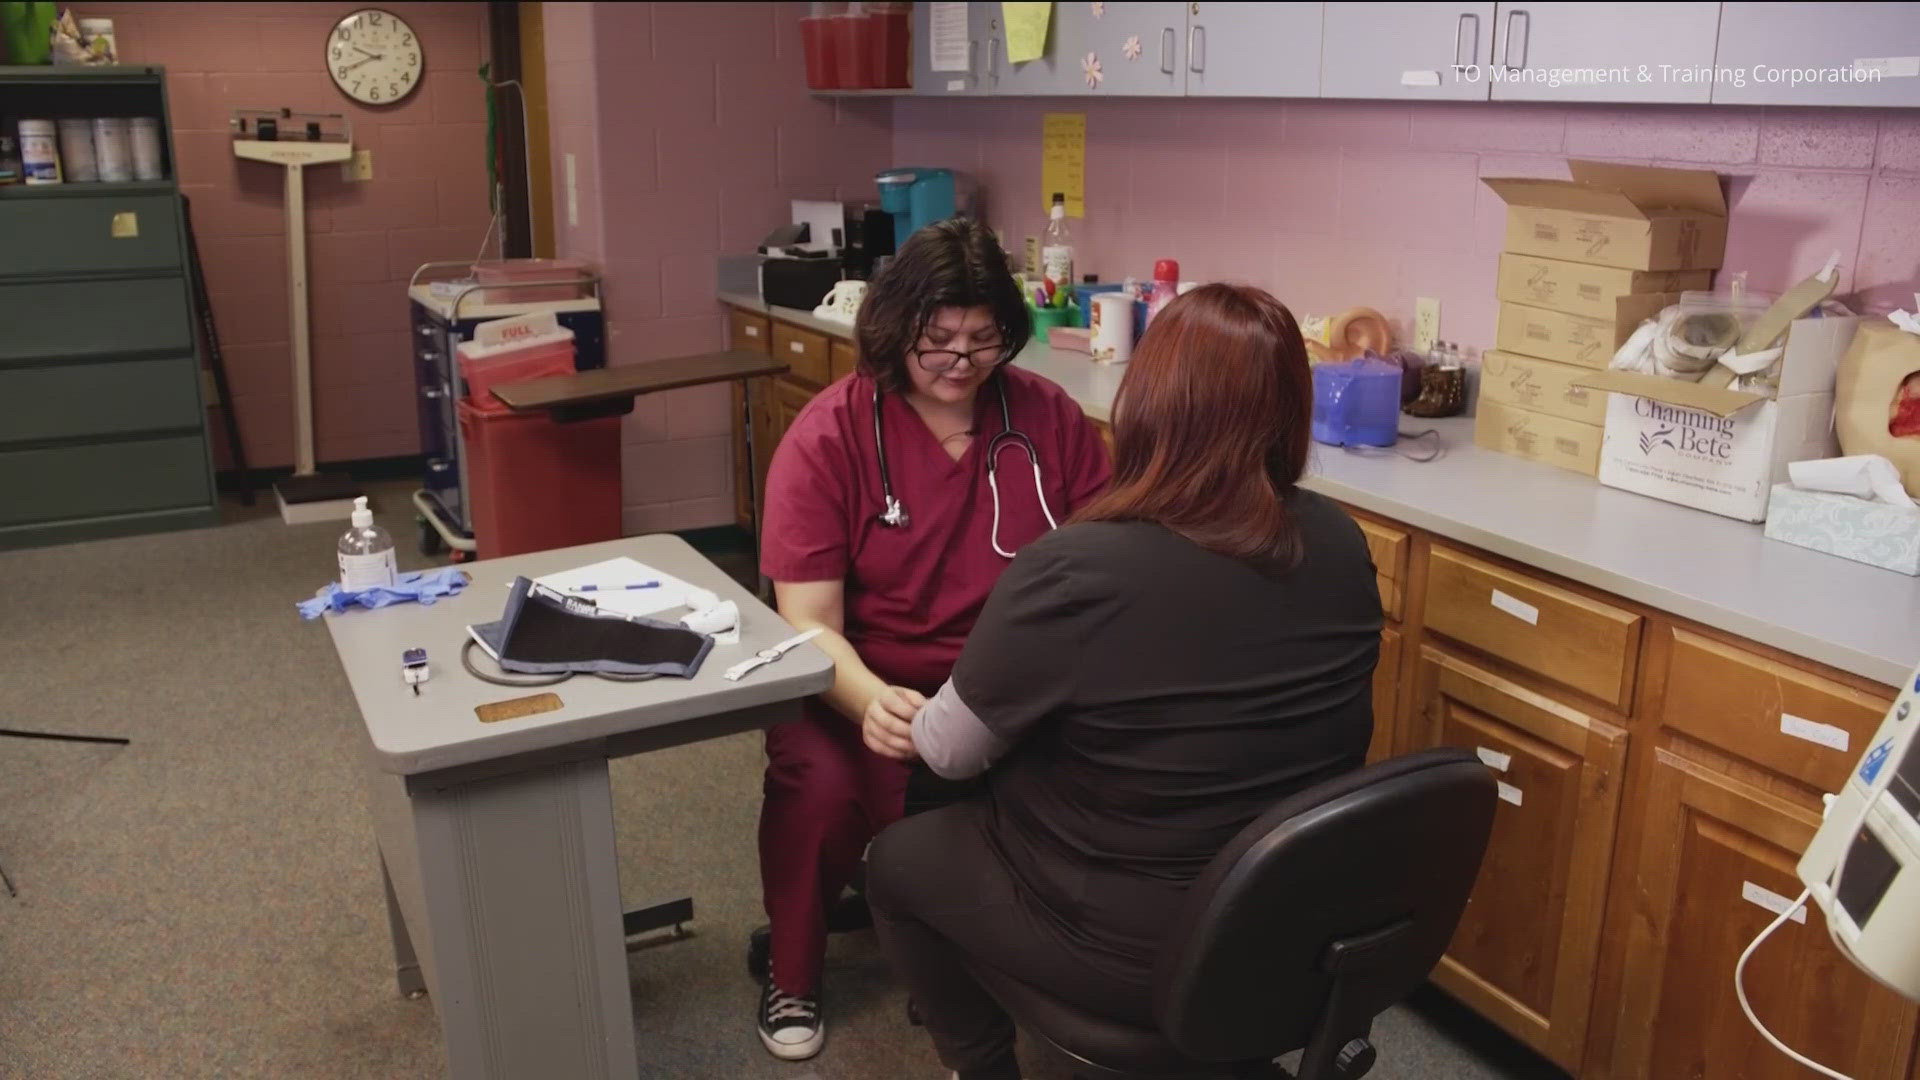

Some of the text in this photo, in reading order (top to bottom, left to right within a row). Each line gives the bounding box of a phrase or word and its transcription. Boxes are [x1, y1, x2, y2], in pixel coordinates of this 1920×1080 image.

[353, 15, 363, 29] 11
[368, 12, 382, 26] 12
[336, 27, 351, 41] 10
[402, 32, 412, 47] 2
[332, 46, 342, 61] 9
[407, 52, 417, 67] 3
[338, 65, 347, 80] 8
[400, 71, 410, 84] 4
[352, 80, 361, 94] 7
[369, 86, 379, 100] 6
[389, 83, 399, 97] 5
[501, 324, 533, 340] FULL
[1635, 397, 1735, 440] Channing
[1680, 427, 1731, 459] Bete
[1677, 450, 1733, 467] COMPANY
